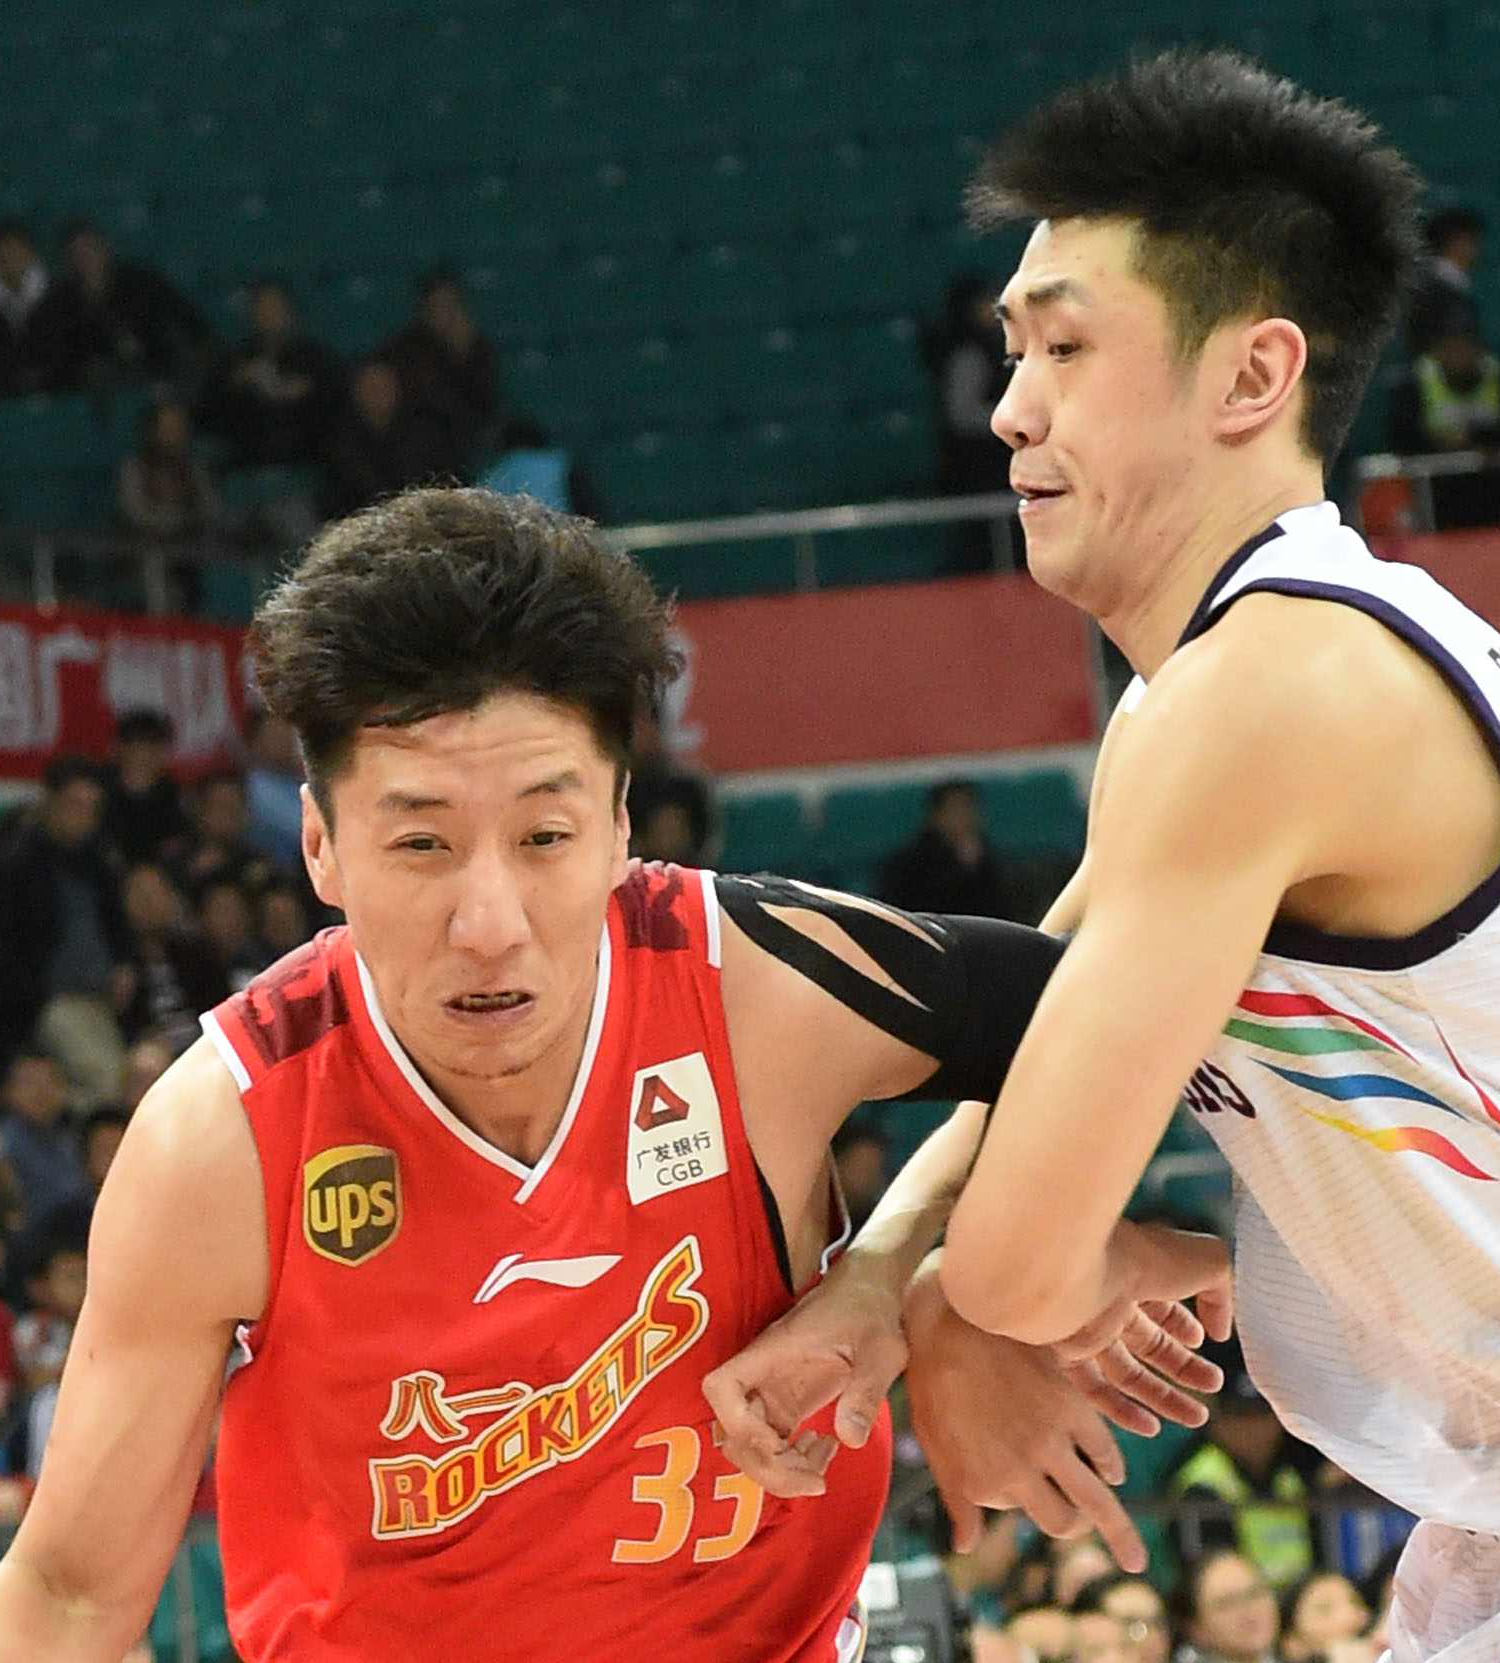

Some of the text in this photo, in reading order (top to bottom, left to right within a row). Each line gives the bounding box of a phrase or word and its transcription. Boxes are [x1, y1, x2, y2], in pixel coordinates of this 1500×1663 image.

[636, 1130, 711, 1170] 广发银行
[656, 1158, 704, 1186] CGB
[310, 1178, 395, 1248] ups
[368, 1235, 710, 1541] ROCKETS
[379, 1370, 533, 1443] 八一
[611, 1425, 765, 1564] 33
